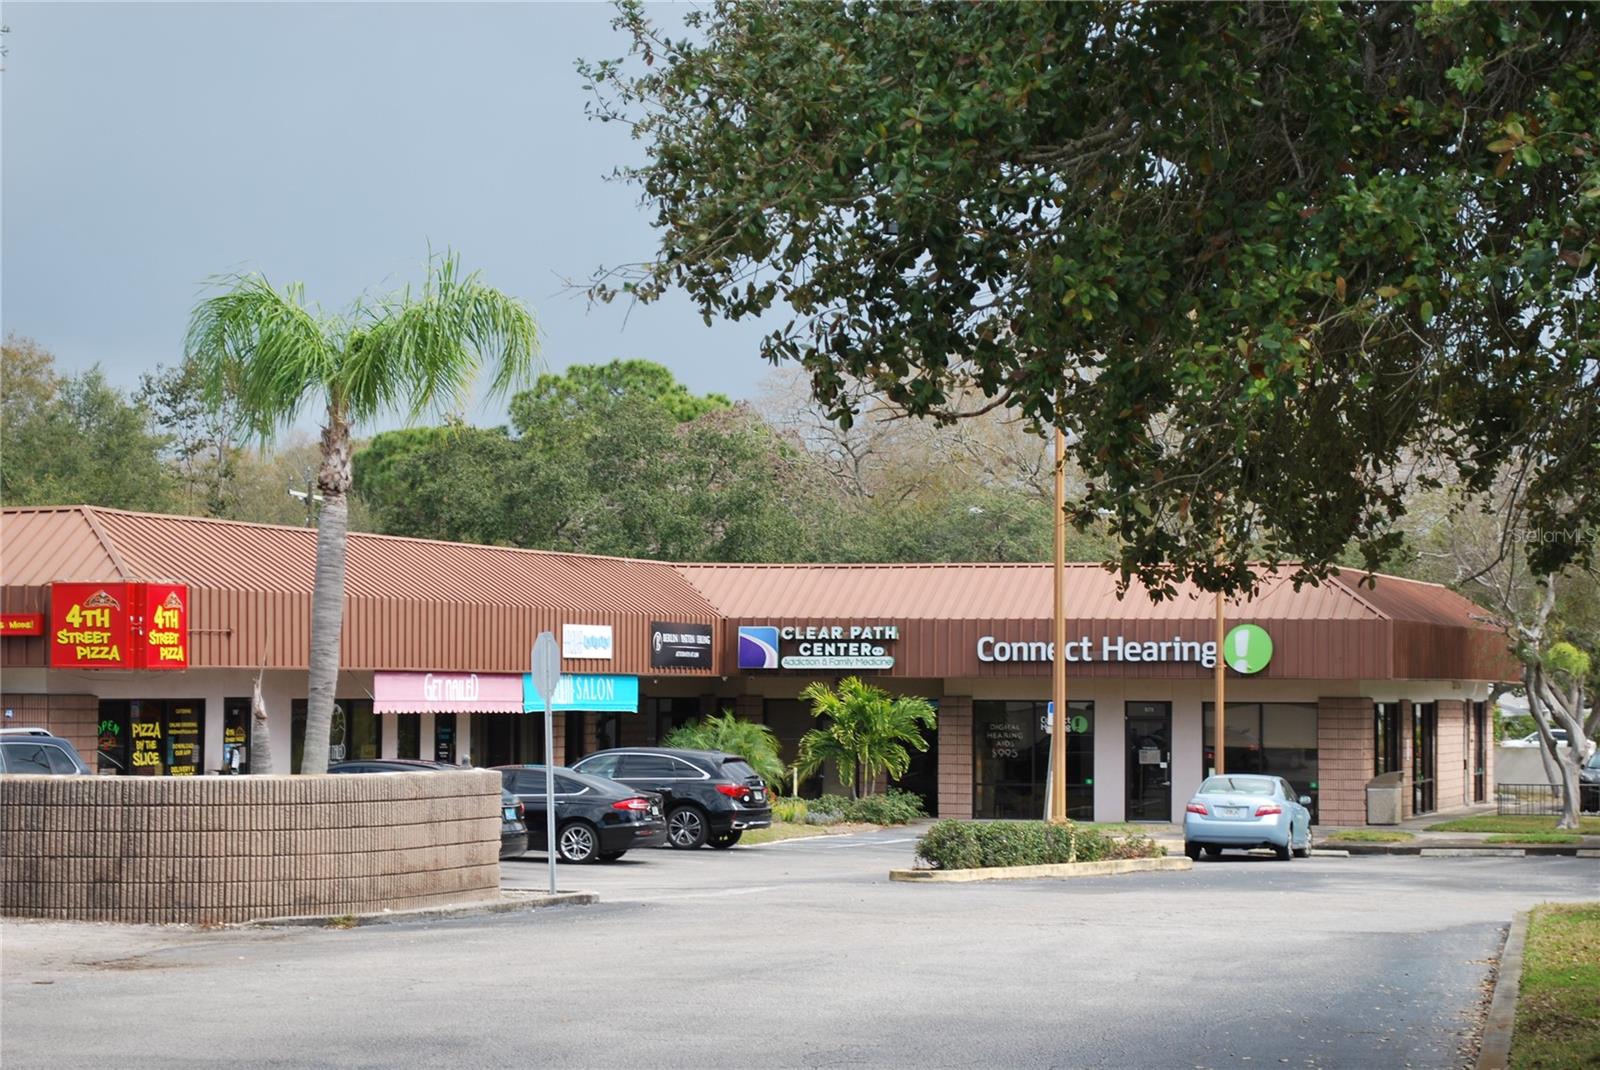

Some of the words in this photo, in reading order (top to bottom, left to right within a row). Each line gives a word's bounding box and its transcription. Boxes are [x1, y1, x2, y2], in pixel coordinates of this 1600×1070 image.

[65, 604, 110, 628] 4TH
[154, 605, 179, 629] 4TH
[57, 629, 111, 645] STREET
[148, 631, 180, 645] STREET
[780, 626, 843, 640] CLEAR
[850, 626, 898, 640] PATH
[76, 645, 121, 661] PIZZA
[159, 646, 185, 661] PIZZA
[799, 643, 872, 656] CENTER
[1102, 635, 1217, 669] Hearing
[784, 658, 821, 666] Addiction
[829, 658, 854, 667] Family
[856, 658, 892, 666] Medicine
[424, 673, 442, 701] GET
[576, 678, 615, 701] SALON
[131, 722, 161, 739] PIZZA
[989, 723, 1020, 731] DIGITAL
[986, 731, 1024, 739] HEARING
[135, 740, 145, 750] BY
[145, 740, 157, 750] THE
[132, 751, 160, 767] SLICE
[991, 749, 1018, 758] $995
